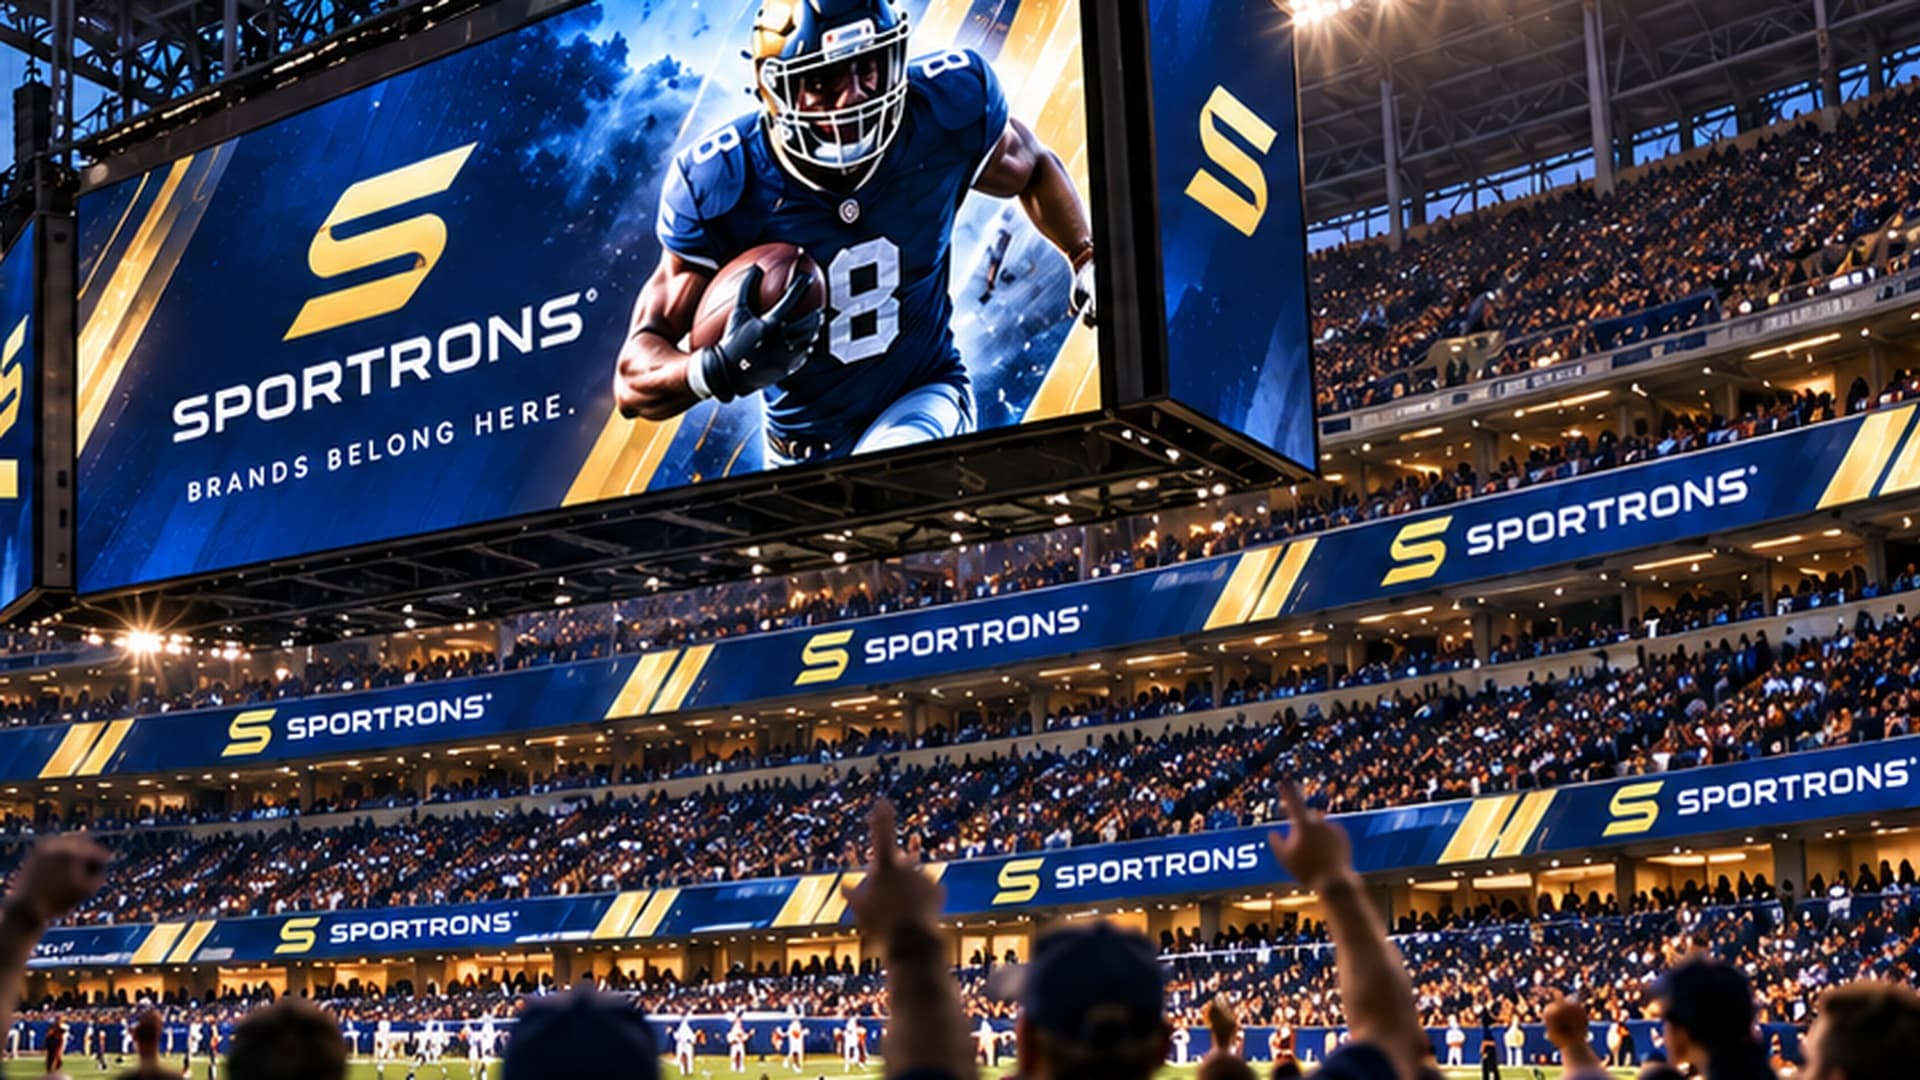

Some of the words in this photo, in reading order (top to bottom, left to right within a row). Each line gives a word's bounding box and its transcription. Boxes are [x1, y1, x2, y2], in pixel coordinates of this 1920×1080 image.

[828, 236, 901, 365] 8
[187, 455, 310, 503] BRANDS
[328, 421, 455, 472] BELONG
[475, 393, 577, 436] HERE.
